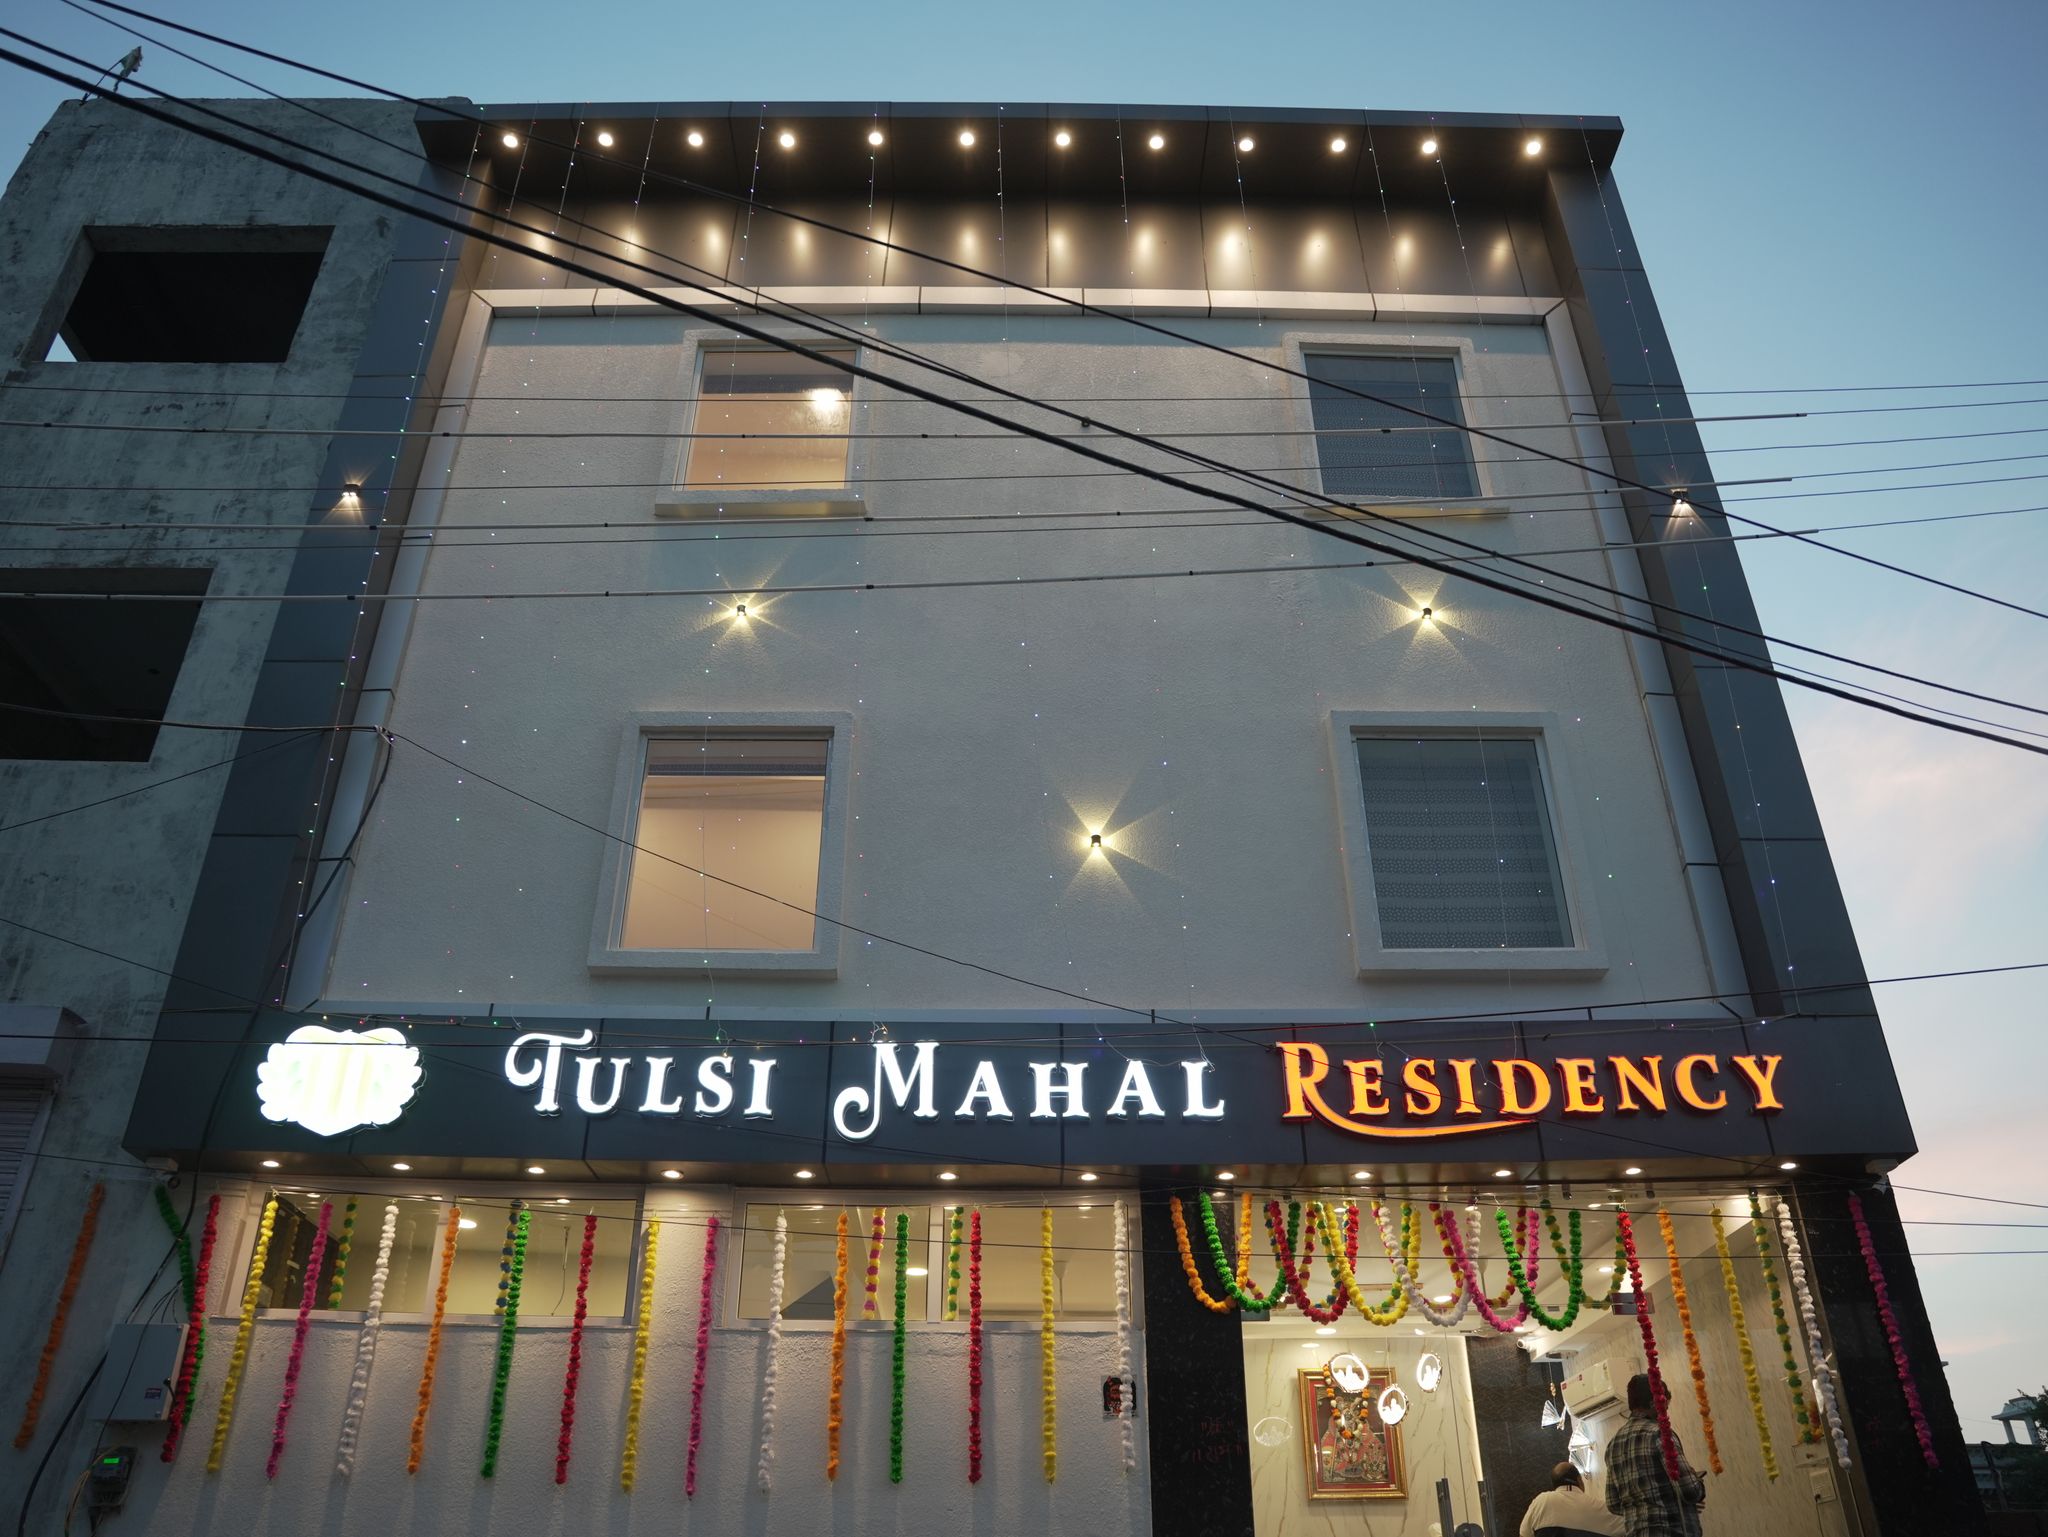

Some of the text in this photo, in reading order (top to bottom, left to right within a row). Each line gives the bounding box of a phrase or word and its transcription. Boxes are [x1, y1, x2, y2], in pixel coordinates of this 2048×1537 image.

[504, 1029, 1785, 1141] TULSI MAHAL RESIDENCY
